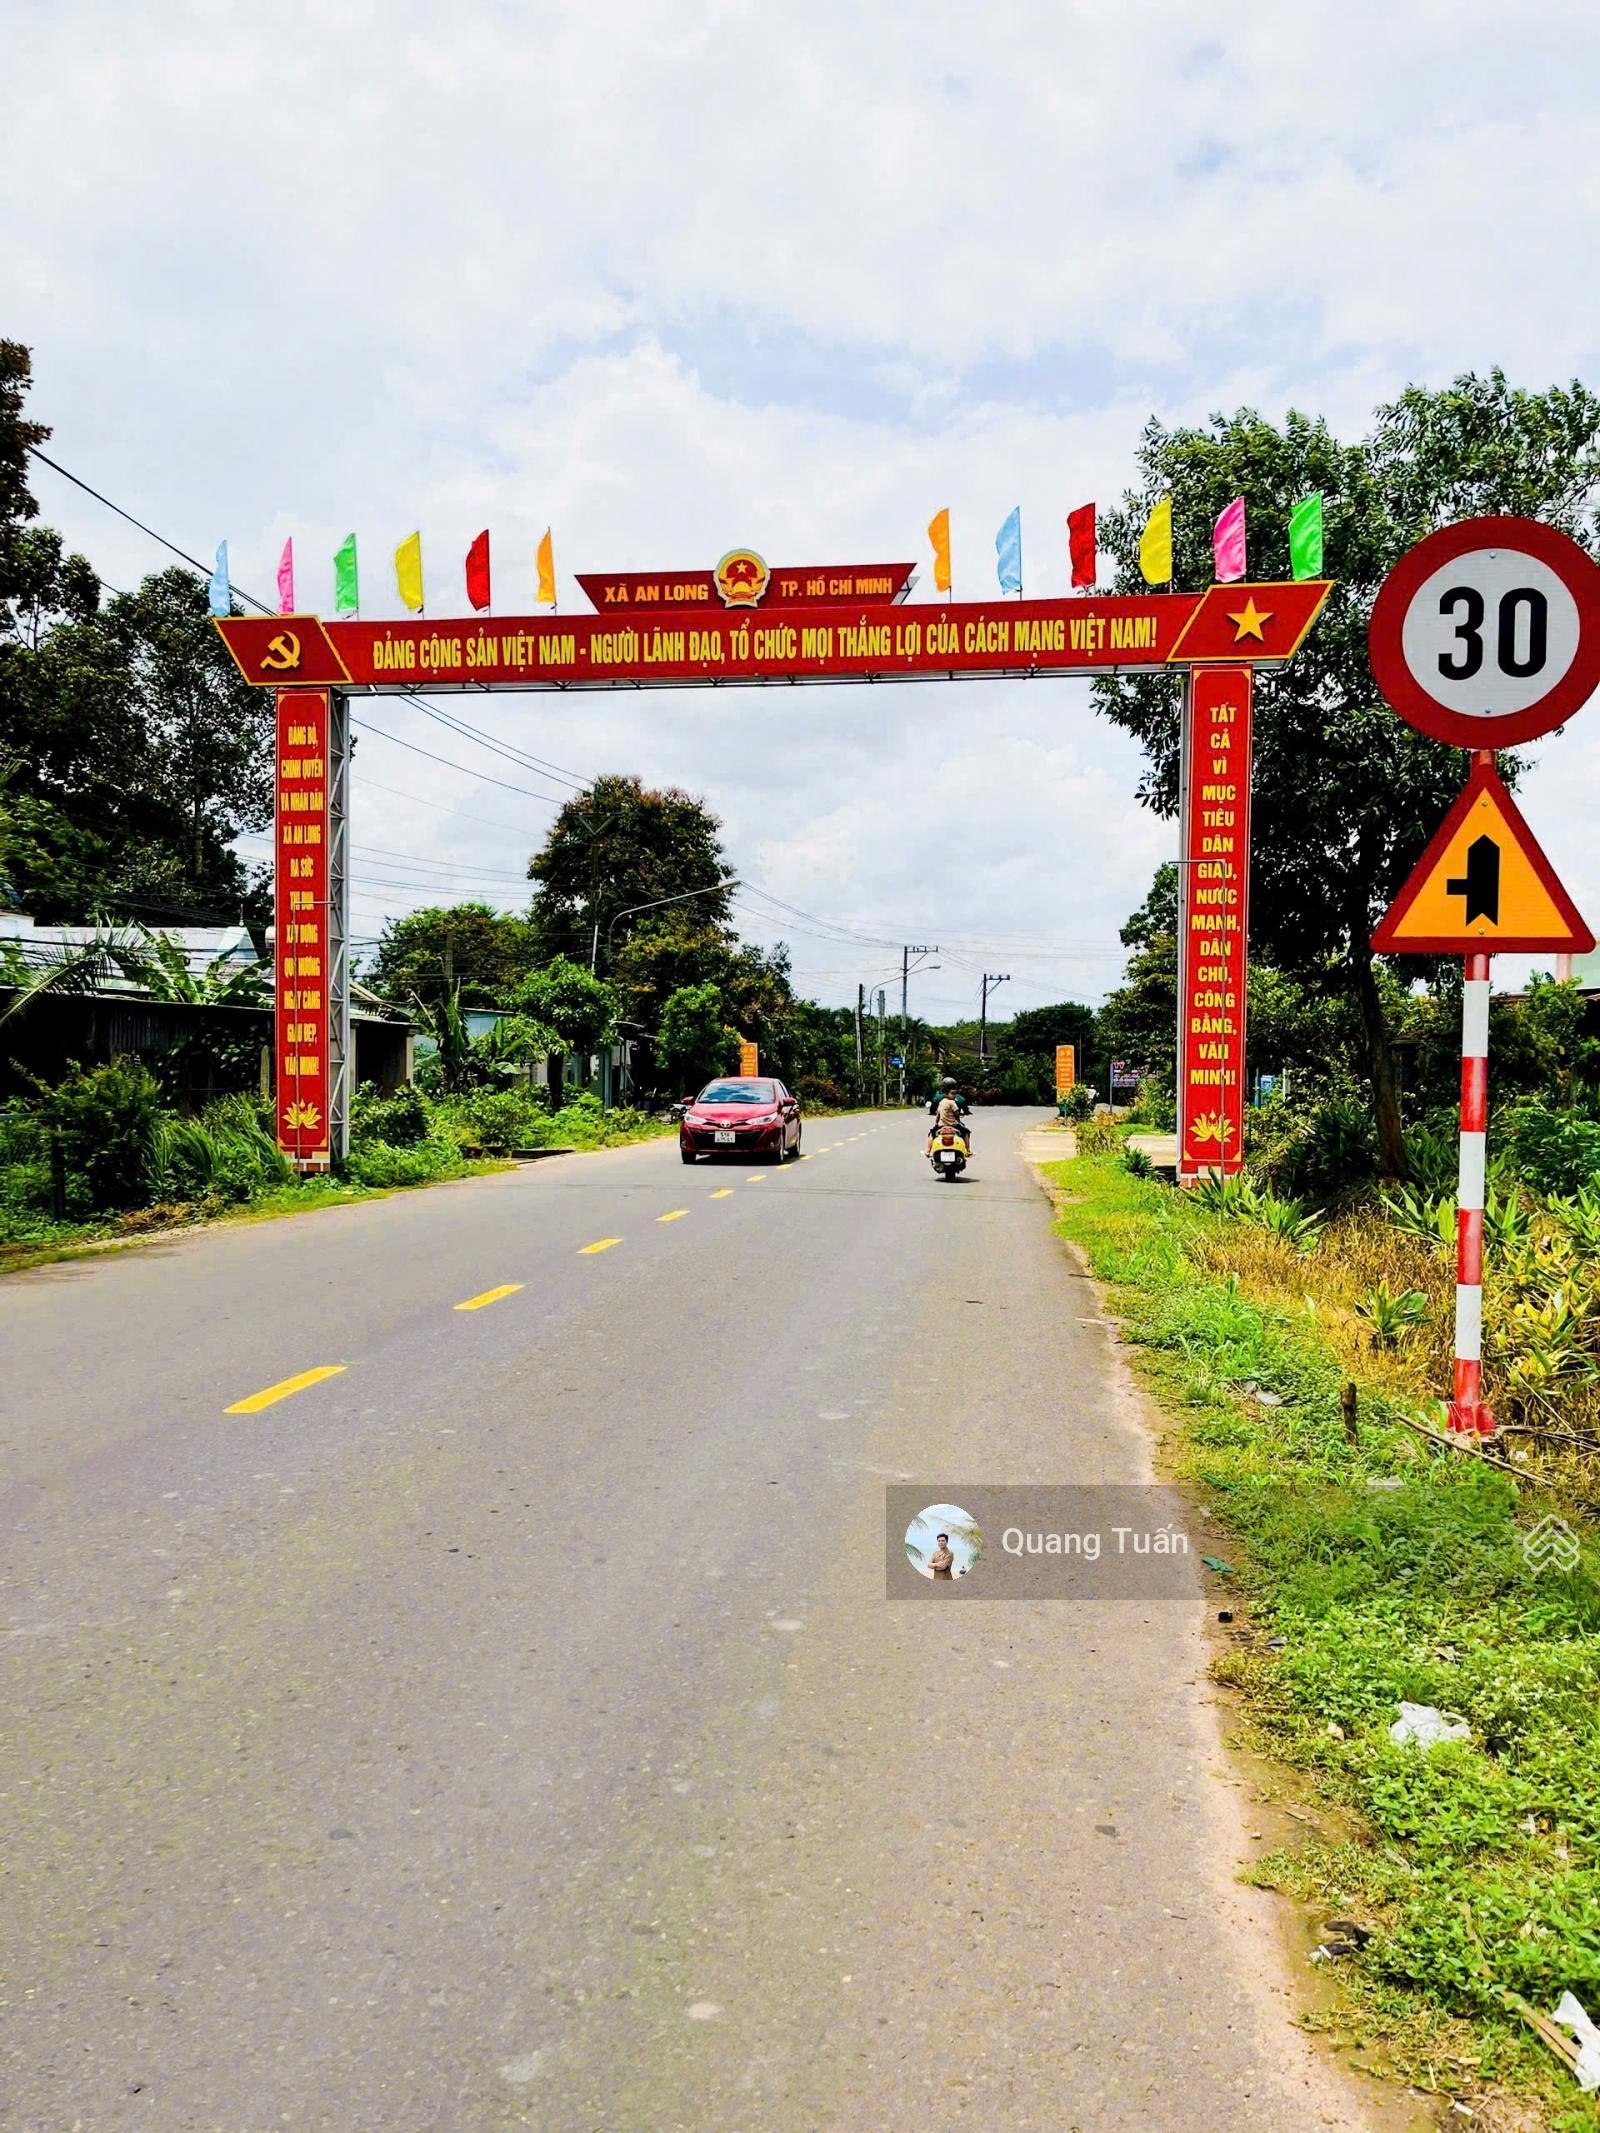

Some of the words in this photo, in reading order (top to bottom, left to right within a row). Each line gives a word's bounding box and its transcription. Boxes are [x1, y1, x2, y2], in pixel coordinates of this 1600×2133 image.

[604, 583, 628, 603] XÃ
[634, 586, 660, 602] AN
[665, 584, 709, 601] LONG
[780, 581, 802, 597] TP.
[806, 575, 826, 596] HỒ
[829, 575, 853, 595] CHÍ
[855, 577, 893, 595] MINH
[373, 630, 416, 669] ĐẢNG
[419, 632, 462, 674] CỘNG
[466, 627, 498, 667] SẢN
[502, 630, 535, 672] VIỆT
[539, 634, 575, 664] NAM
[591, 626, 639, 664] NGƯỜI
[643, 627, 685, 662] LÃNH
[688, 630, 725, 668] ĐẠO,
[730, 617, 751, 660] TỔ
[754, 622, 797, 660] CHỨC
[802, 627, 833, 665] MỌI
[837, 614, 891, 657] THẮNG
[896, 621, 921, 662] LỢI
[926, 612, 960, 654] CỦA
[964, 615, 1009, 653] CÁCH
[1014, 620, 1065, 658] MẠNG
[1069, 612, 1106, 656] VIỆT
[1110, 617, 1157, 649] NAM!
[1438, 586, 1548, 681] 30
[1209, 702, 1237, 723] TẤT
[1210, 728, 1231, 749] CẢ
[1212, 755, 1227, 775] VÌ
[1202, 786, 1236, 804] MỤC
[1202, 808, 1235, 827] TIÊU
[1202, 834, 1234, 853] DÂN
[1199, 938, 1231, 956] DÂN
[1194, 989, 1236, 1008] CÔNG
